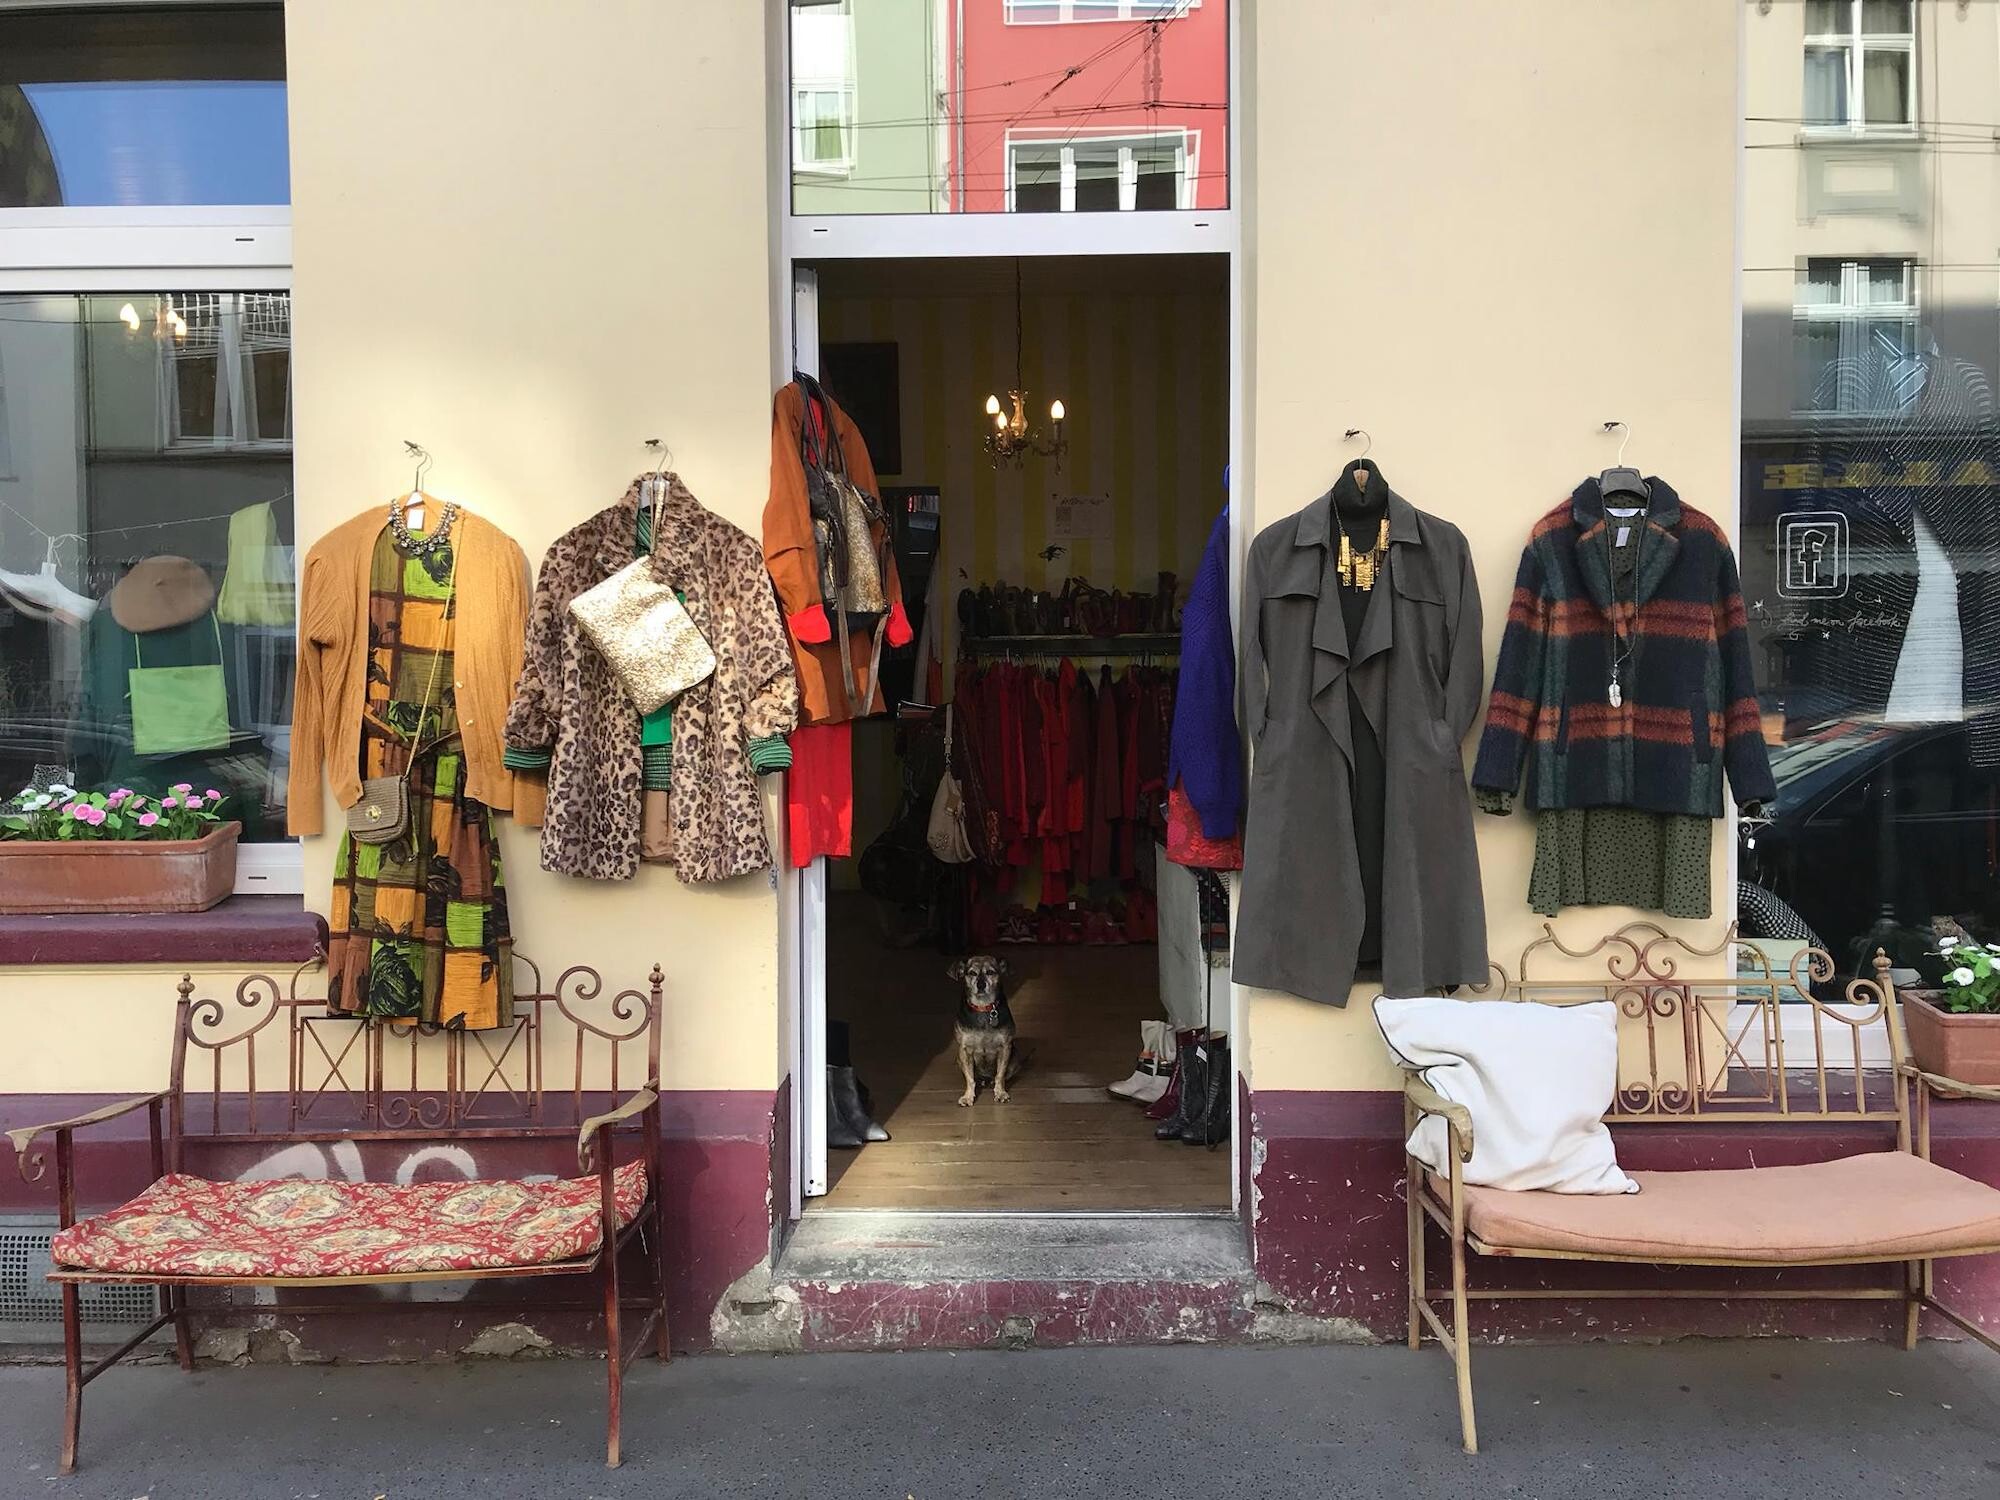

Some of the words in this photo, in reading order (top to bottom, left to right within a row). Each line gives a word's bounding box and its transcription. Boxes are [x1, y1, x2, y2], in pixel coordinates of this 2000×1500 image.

[1798, 529, 1827, 585] f
[1810, 617, 1829, 627] me
[1829, 618, 1845, 627] on
[1847, 610, 1901, 634] facebook
